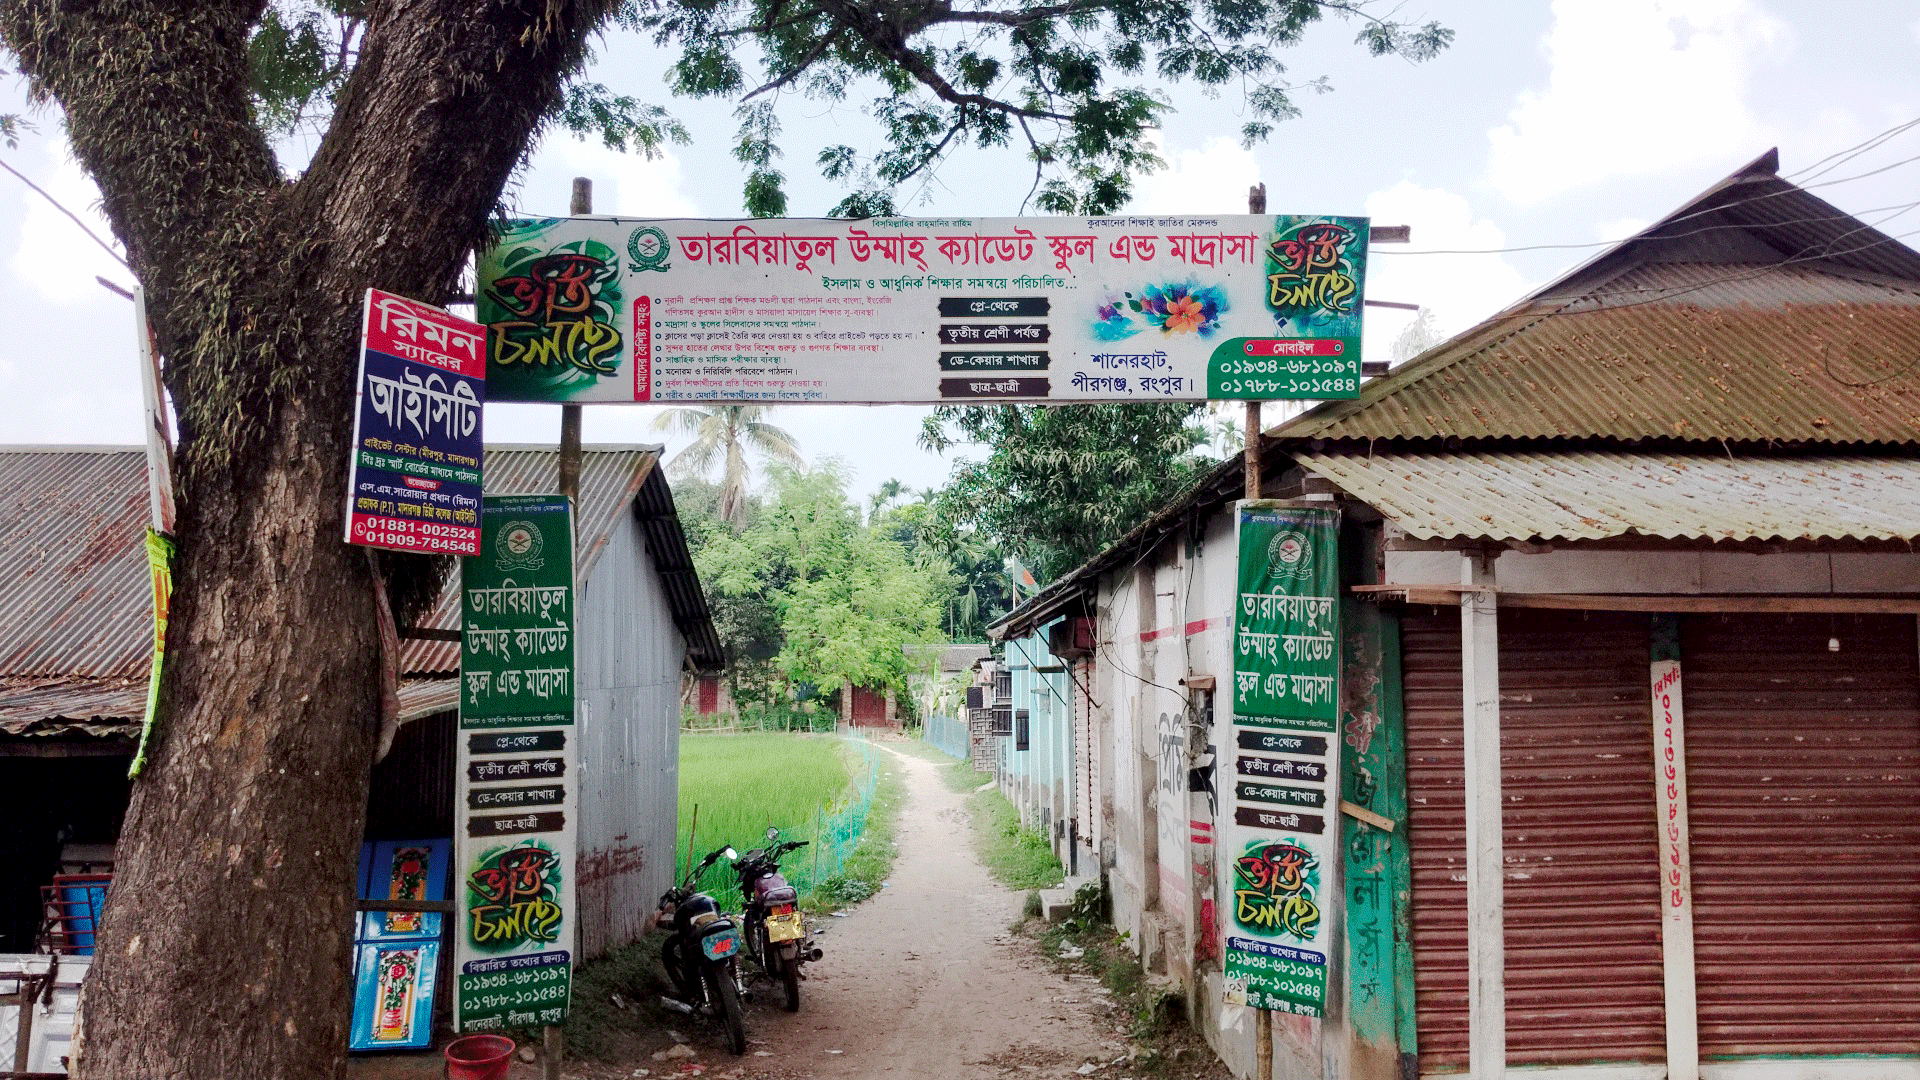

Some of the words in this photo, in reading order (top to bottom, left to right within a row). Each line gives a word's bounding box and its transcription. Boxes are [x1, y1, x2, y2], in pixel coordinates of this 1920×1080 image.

[1086, 218, 1126, 229] কুরআনের
[1128, 217, 1155, 228] শিক্ষাই
[1157, 217, 1184, 228] জাতির
[677, 225, 840, 275] তারবিয়াতুল
[934, 225, 1038, 266] ক্যাডেট
[1044, 235, 1099, 275] স্কুল
[1109, 234, 1160, 264] এন্ড
[1165, 231, 1260, 269] মাদ্রাসা
[1265, 223, 1349, 275] ভর্তি
[484, 253, 606, 322] ভর্তি
[821, 275, 861, 290] ইসলাম
[865, 279, 875, 290] ও
[879, 275, 923, 293] আধুনিক
[927, 274, 963, 290] শিক্ষার
[1267, 269, 1356, 311] চলছে
[970, 300, 1019, 313] প্লে-থেকে
[373, 298, 485, 361] রিমন
[948, 325, 981, 343] তৃতীয়
[984, 325, 1010, 339] শ্রেণী
[1013, 325, 1041, 339] পর্যন্ত
[392, 339, 464, 371] স্যারের
[488, 315, 622, 373] চলছে
[1272, 341, 1315, 355] মোবাইল
[949, 355, 1003, 366] ডে-কেয়ার
[1006, 355, 1040, 366] শাখায়
[1090, 349, 1173, 372] শানেরহাট,
[1220, 360, 1358, 375] ০১৯৩৪-৬৮১০৯৭
[969, 379, 1020, 394] ছাত্র-ছাত্রী
[1071, 373, 1133, 396] পীরগঞ্জ,
[1220, 379, 1356, 393] ০১৭৮৮-১০১৫৪৪
[367, 366, 481, 440] আইসিটি
[452, 494, 478, 509] (রিমন)
[367, 517, 476, 540] 01881-002524
[366, 531, 476, 553] 01909-784546
[467, 577, 569, 622] তারবিয়াতুল
[1240, 584, 1335, 631] তারবিয়াতুল
[514, 617, 570, 656] ক্যাডেট
[1281, 627, 1335, 663] ক্যাডেট
[465, 670, 492, 708] স্কুল
[497, 669, 521, 698] এন্ড
[524, 664, 570, 700] মাদ্রাসা
[1235, 670, 1260, 706] স্কুল
[1264, 672, 1288, 700] এন্ড
[1290, 672, 1334, 706] মাদ্রাসা
[496, 735, 539, 748] প্লে-থেকে
[1262, 736, 1302, 748] প্লে-থেকে
[477, 761, 505, 780] তৃতীয়
[508, 760, 530, 774] শ্রেণী
[533, 760, 558, 773] পর্যন্ত
[1243, 758, 1270, 774] তৃতীয়
[1272, 761, 1294, 775] শ্রেণী
[1296, 763, 1320, 777] পর্যন্ত
[478, 790, 525, 803] ডে-কেয়ার
[527, 789, 556, 800] শাখায়
[1244, 786, 1287, 800] ডে-কেয়ার
[1289, 790, 1317, 803] শাখায়
[495, 815, 539, 831] ছাত্র-ছাত্রী
[1259, 813, 1300, 828] ছাত্র-ছাত্রী
[467, 848, 553, 906] ভর্তি
[1233, 844, 1312, 895] ভর্তি
[469, 897, 562, 942] চলছে
[1235, 890, 1320, 939] চলছে
[1233, 937, 1268, 953] বিস্তারিত
[1270, 945, 1297, 959] তথ্যের
[469, 960, 508, 974] বিস্তারিত
[511, 957, 540, 969] তথ্যের
[1228, 952, 1323, 981] ০১৯৩৪-৬৮১০৯৭
[463, 966, 567, 991] ০১৯৩৪-৬৮১০৯৭
[463, 985, 566, 1010] ০১৭৮৮-১০১৫৪৪
